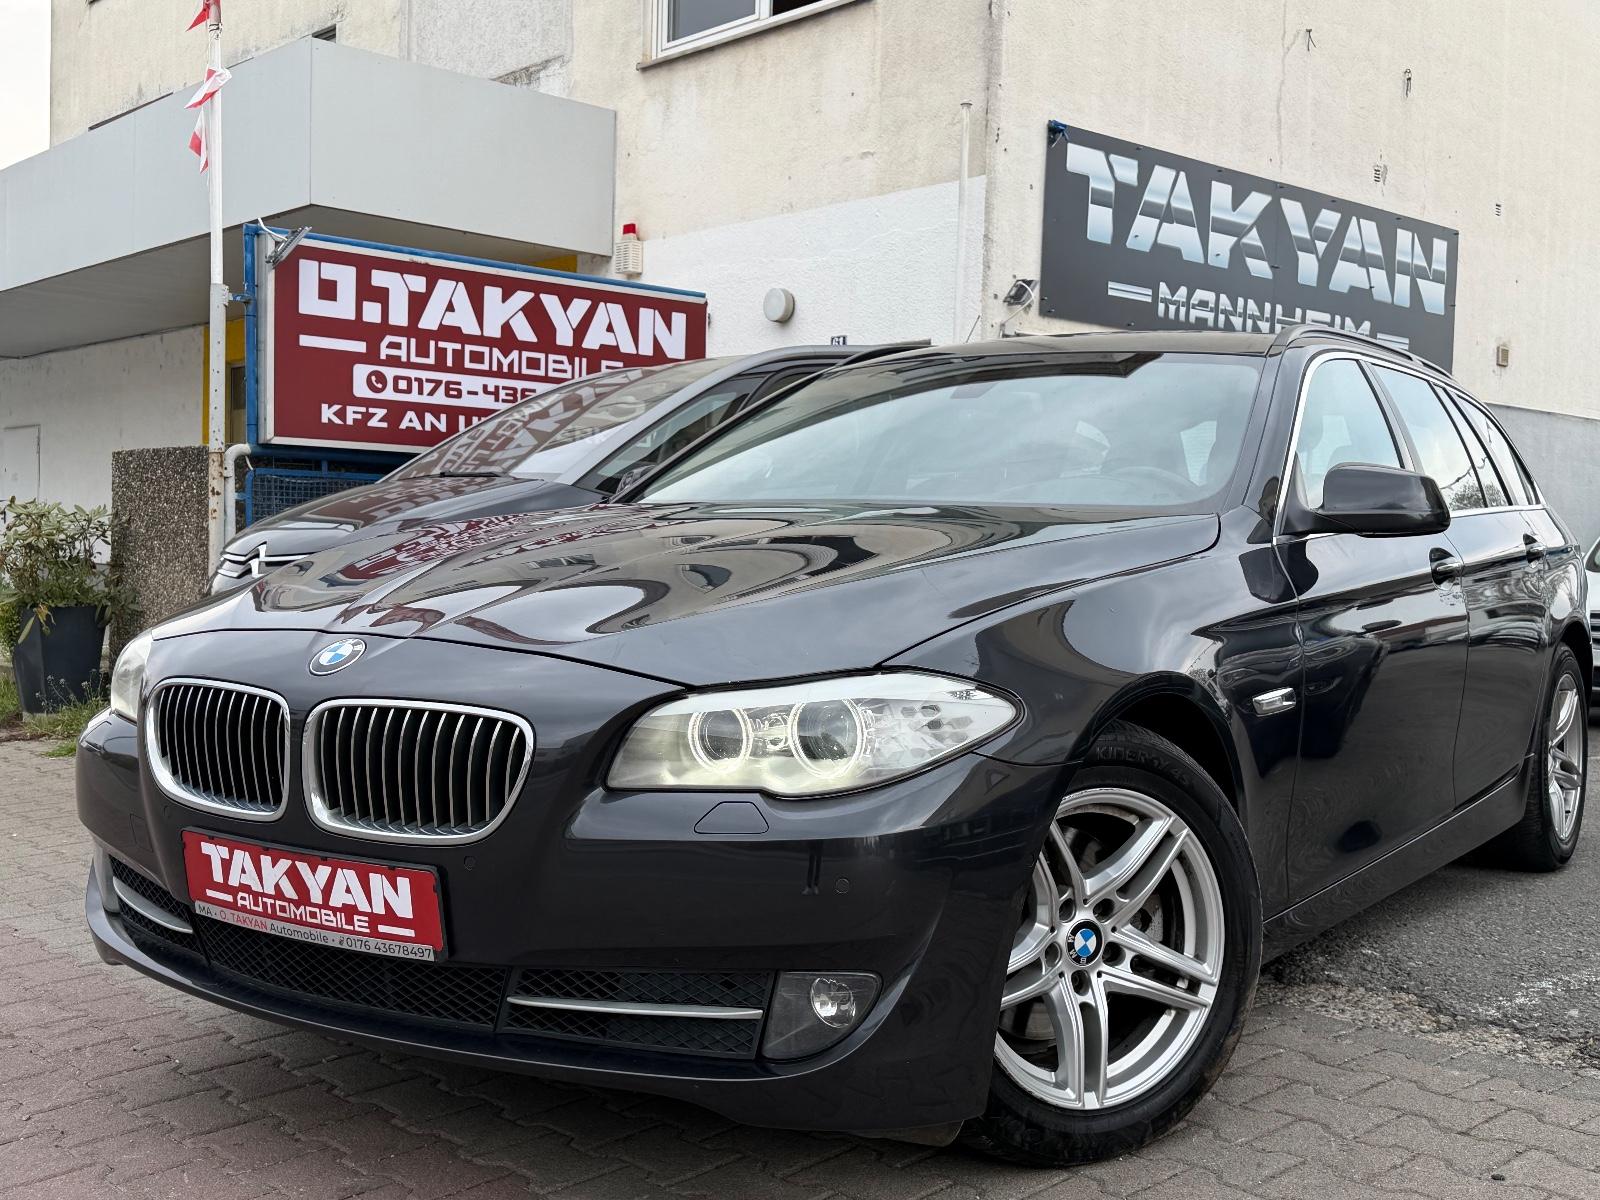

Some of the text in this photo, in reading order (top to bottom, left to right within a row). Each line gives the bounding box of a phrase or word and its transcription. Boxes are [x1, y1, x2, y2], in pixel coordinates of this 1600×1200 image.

[1066, 142, 1448, 316] TAKYAN
[320, 403, 388, 428] KFZ
[399, 411, 447, 432] AN
[200, 841, 413, 918] TAKYAN
[198, 904, 213, 917] MA
[230, 912, 268, 931] TAKYAN
[270, 922, 329, 944] Automobile
[346, 937, 371, 951] 0176
[374, 942, 432, 959] 43678497
[237, 891, 370, 933] AUTOMOBILE
